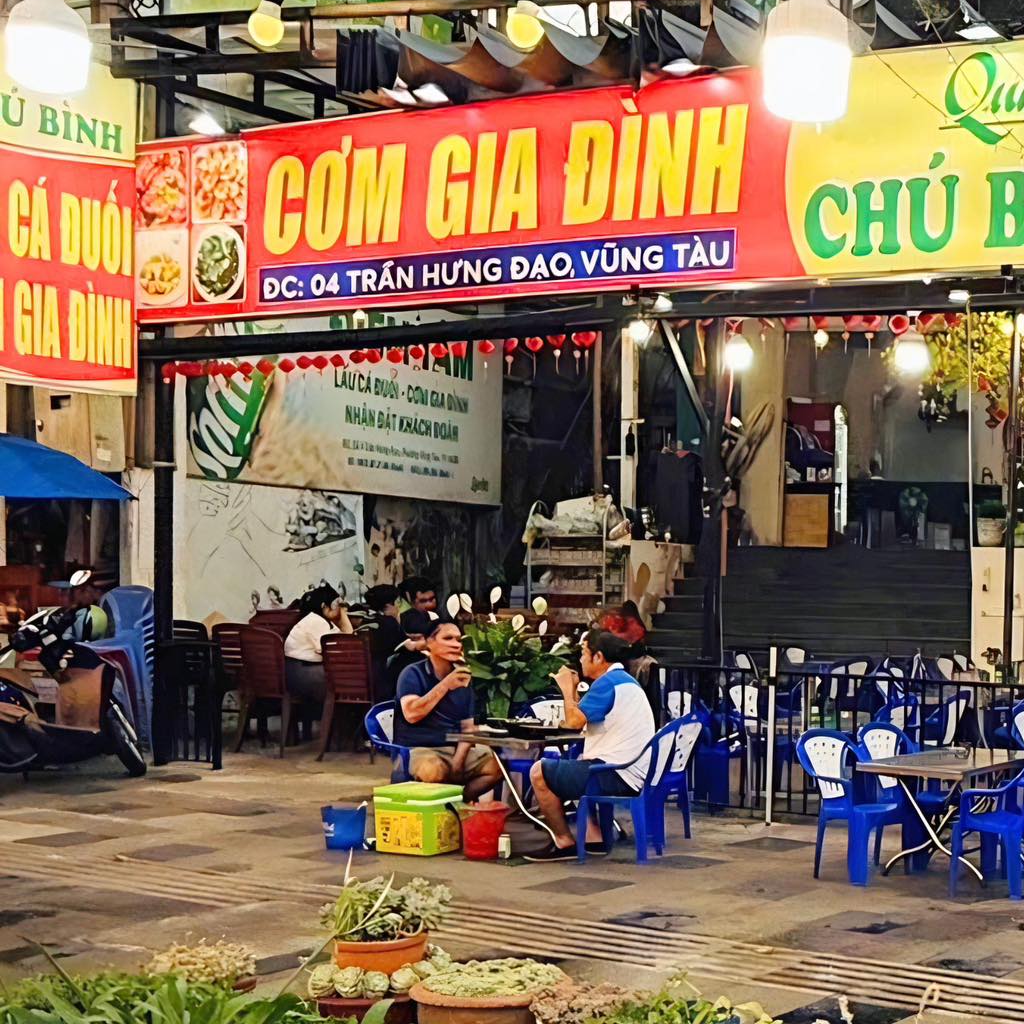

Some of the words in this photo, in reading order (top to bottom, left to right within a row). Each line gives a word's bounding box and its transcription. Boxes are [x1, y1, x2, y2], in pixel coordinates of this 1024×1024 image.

[7, 176, 52, 263] CÁ
[263, 133, 408, 256] CƠM
[425, 126, 539, 241] GIA
[561, 96, 750, 226] ĐÌNH
[803, 150, 960, 260] CHÚ
[262, 276, 304, 301] ĐC:
[310, 274, 341, 297] 04
[422, 257, 503, 288] HƯNG
[509, 250, 576, 281] ĐẠO,
[580, 240, 665, 276] VŨNG
[671, 233, 732, 269] TÀU
[13, 278, 62, 360] GIA
